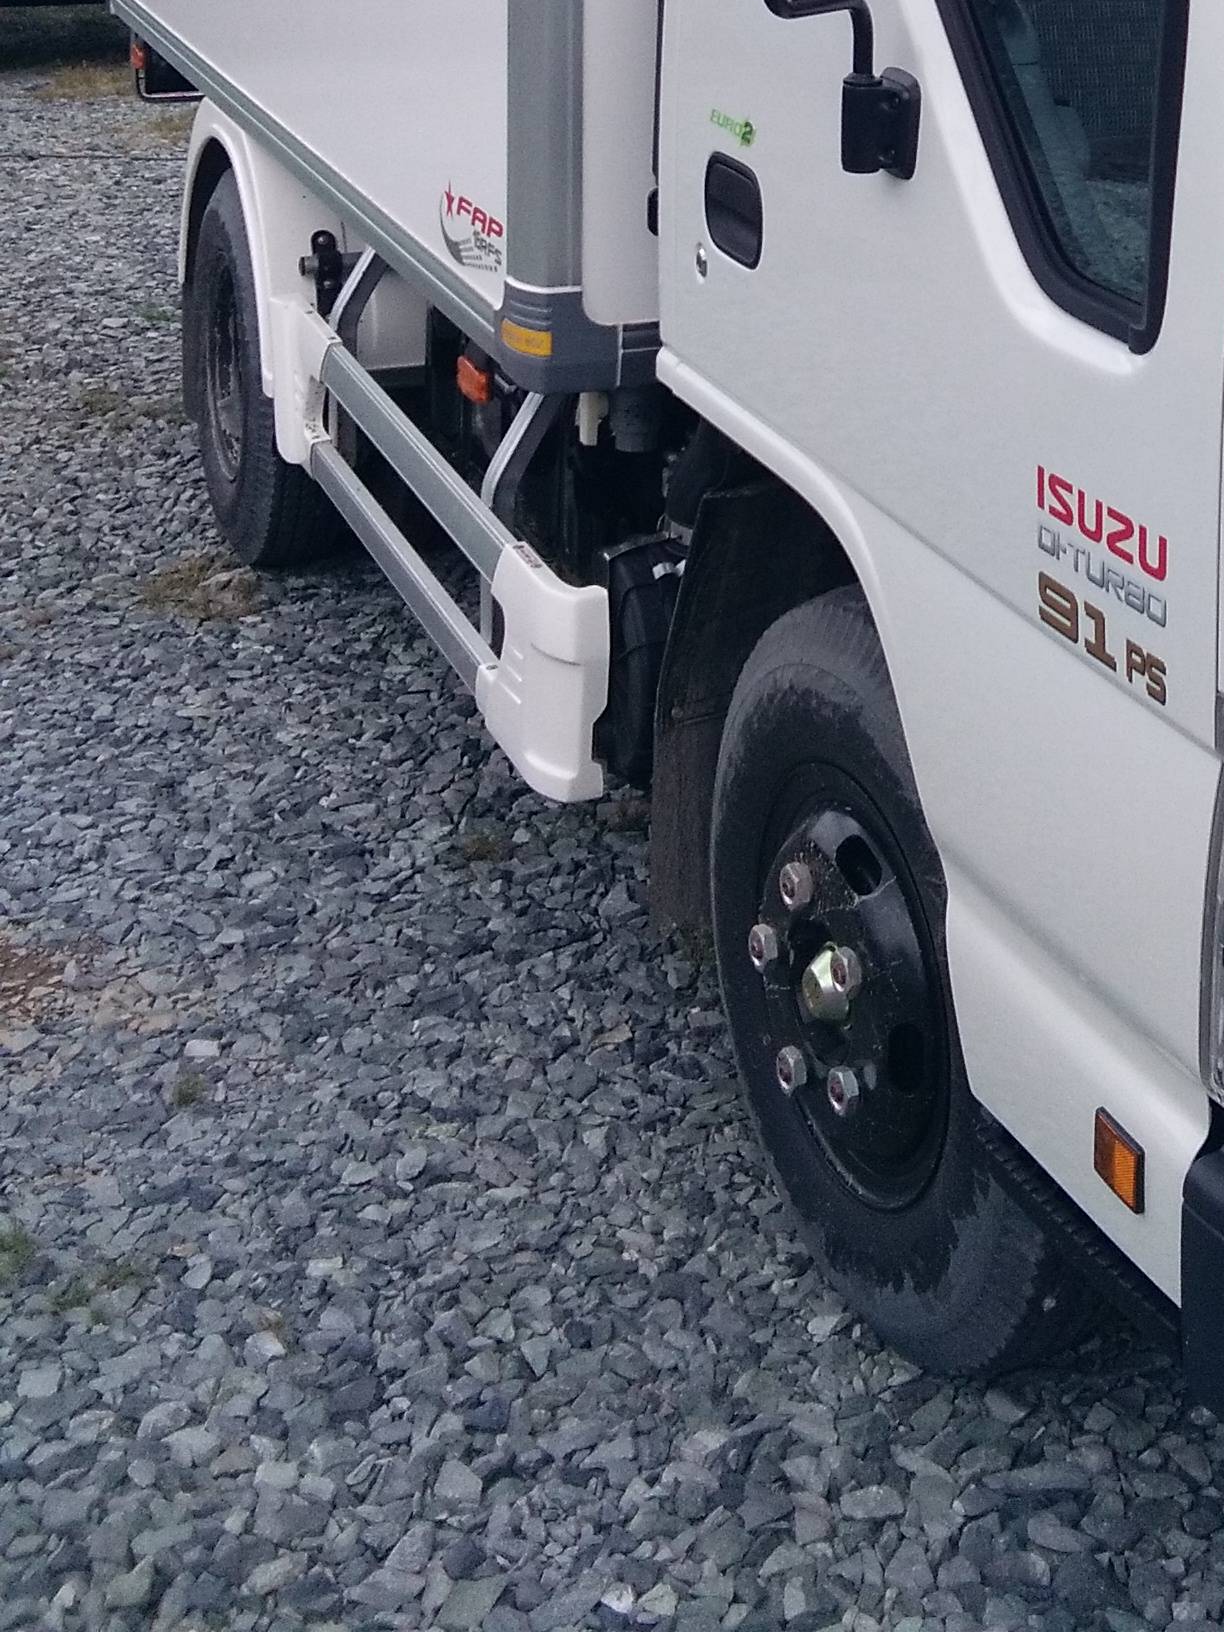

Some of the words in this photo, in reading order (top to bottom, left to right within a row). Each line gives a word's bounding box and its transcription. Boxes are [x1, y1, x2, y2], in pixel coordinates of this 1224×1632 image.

[1037, 464, 1168, 582] ISUZU
[1038, 570, 1117, 673] 91
[1125, 637, 1167, 706] PS
